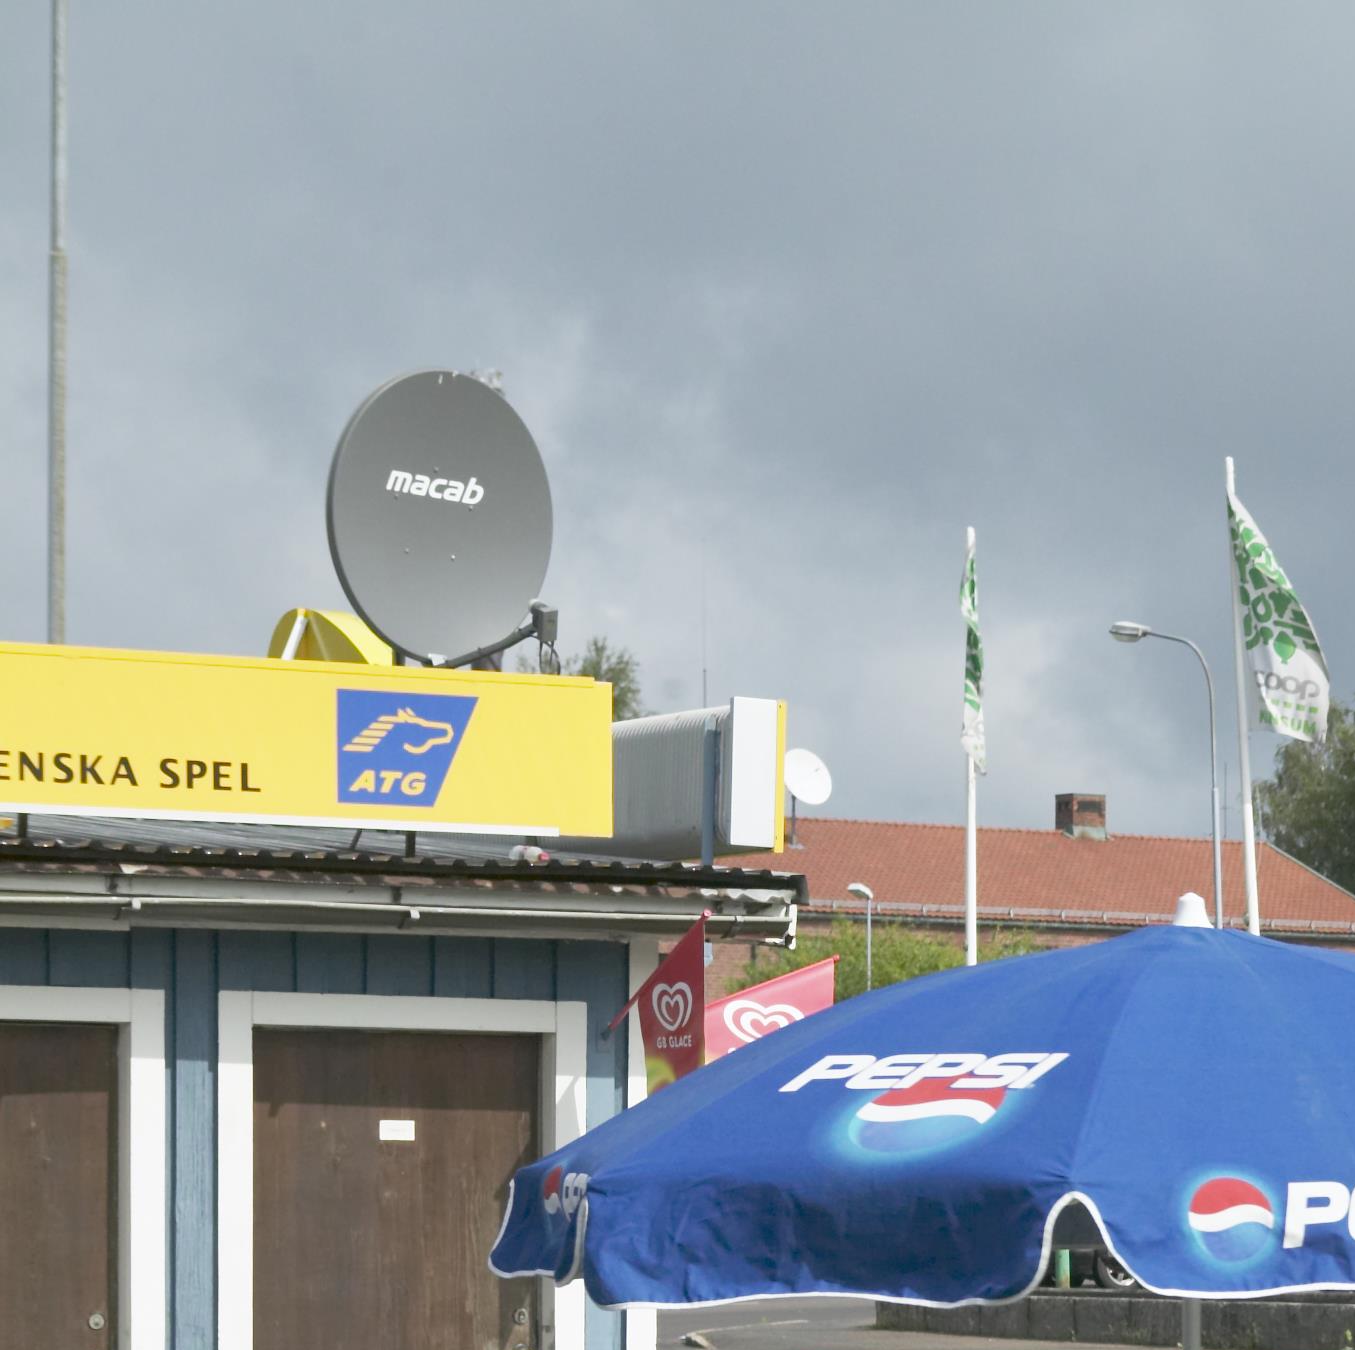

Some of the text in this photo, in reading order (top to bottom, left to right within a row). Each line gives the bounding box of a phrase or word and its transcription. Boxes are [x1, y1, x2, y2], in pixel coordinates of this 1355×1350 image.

[386, 470, 484, 504] macab
[160, 758, 261, 793] SPEL
[349, 769, 427, 797] ATG
[656, 1034, 692, 1049] GB GLACE
[778, 1052, 1070, 1093] PEPSI
